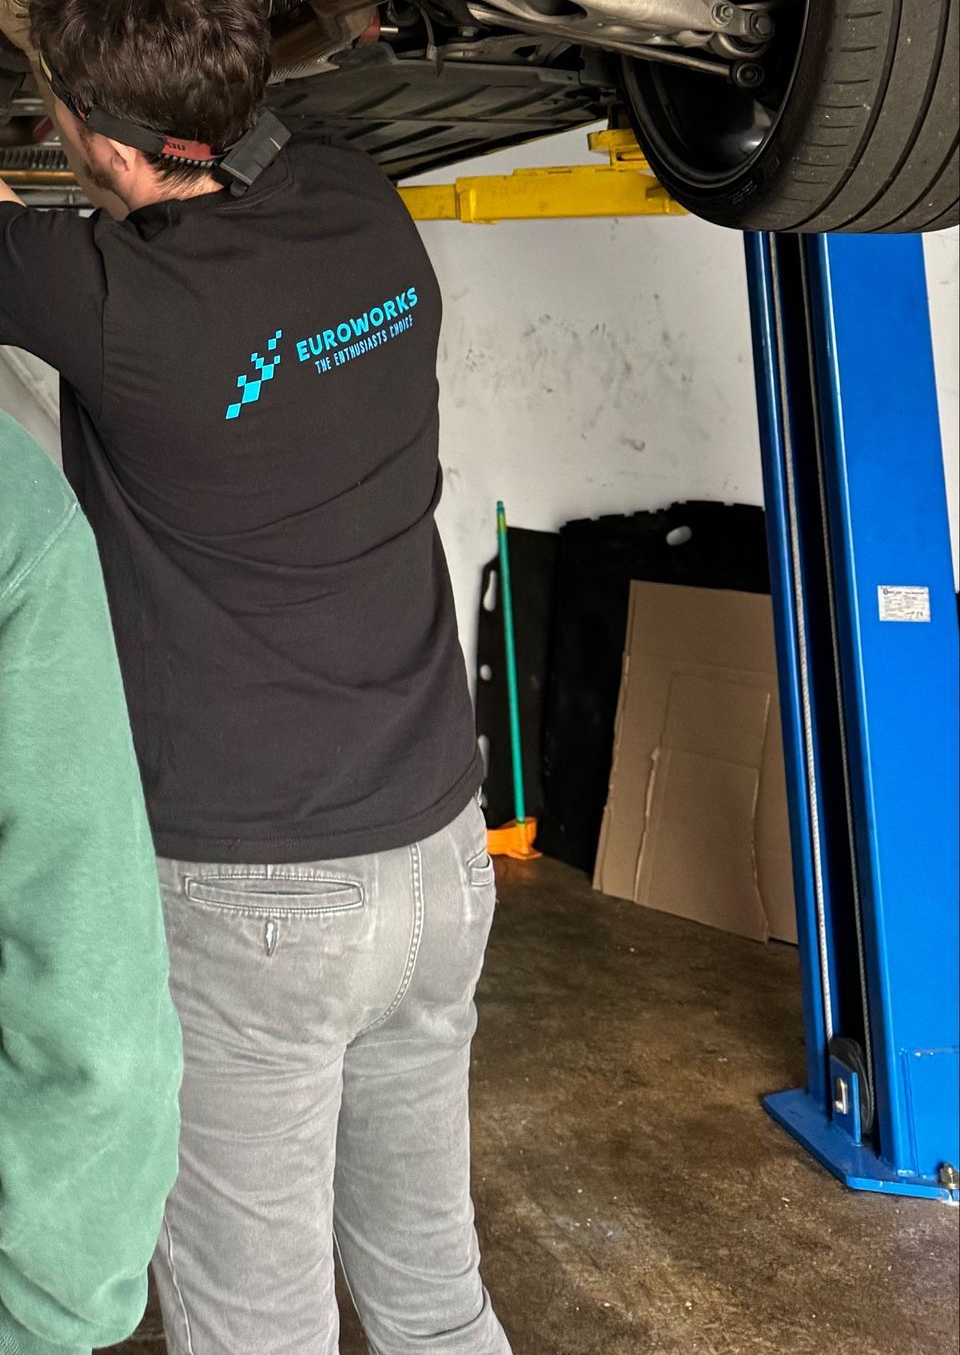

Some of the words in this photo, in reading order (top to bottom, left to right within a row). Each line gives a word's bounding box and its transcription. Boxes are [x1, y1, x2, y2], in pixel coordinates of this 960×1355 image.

[296, 287, 418, 362] EUROWORKS
[314, 357, 332, 374] THE
[333, 329, 388, 366] ENTHUSIASTS
[389, 314, 414, 338] CHOICE
